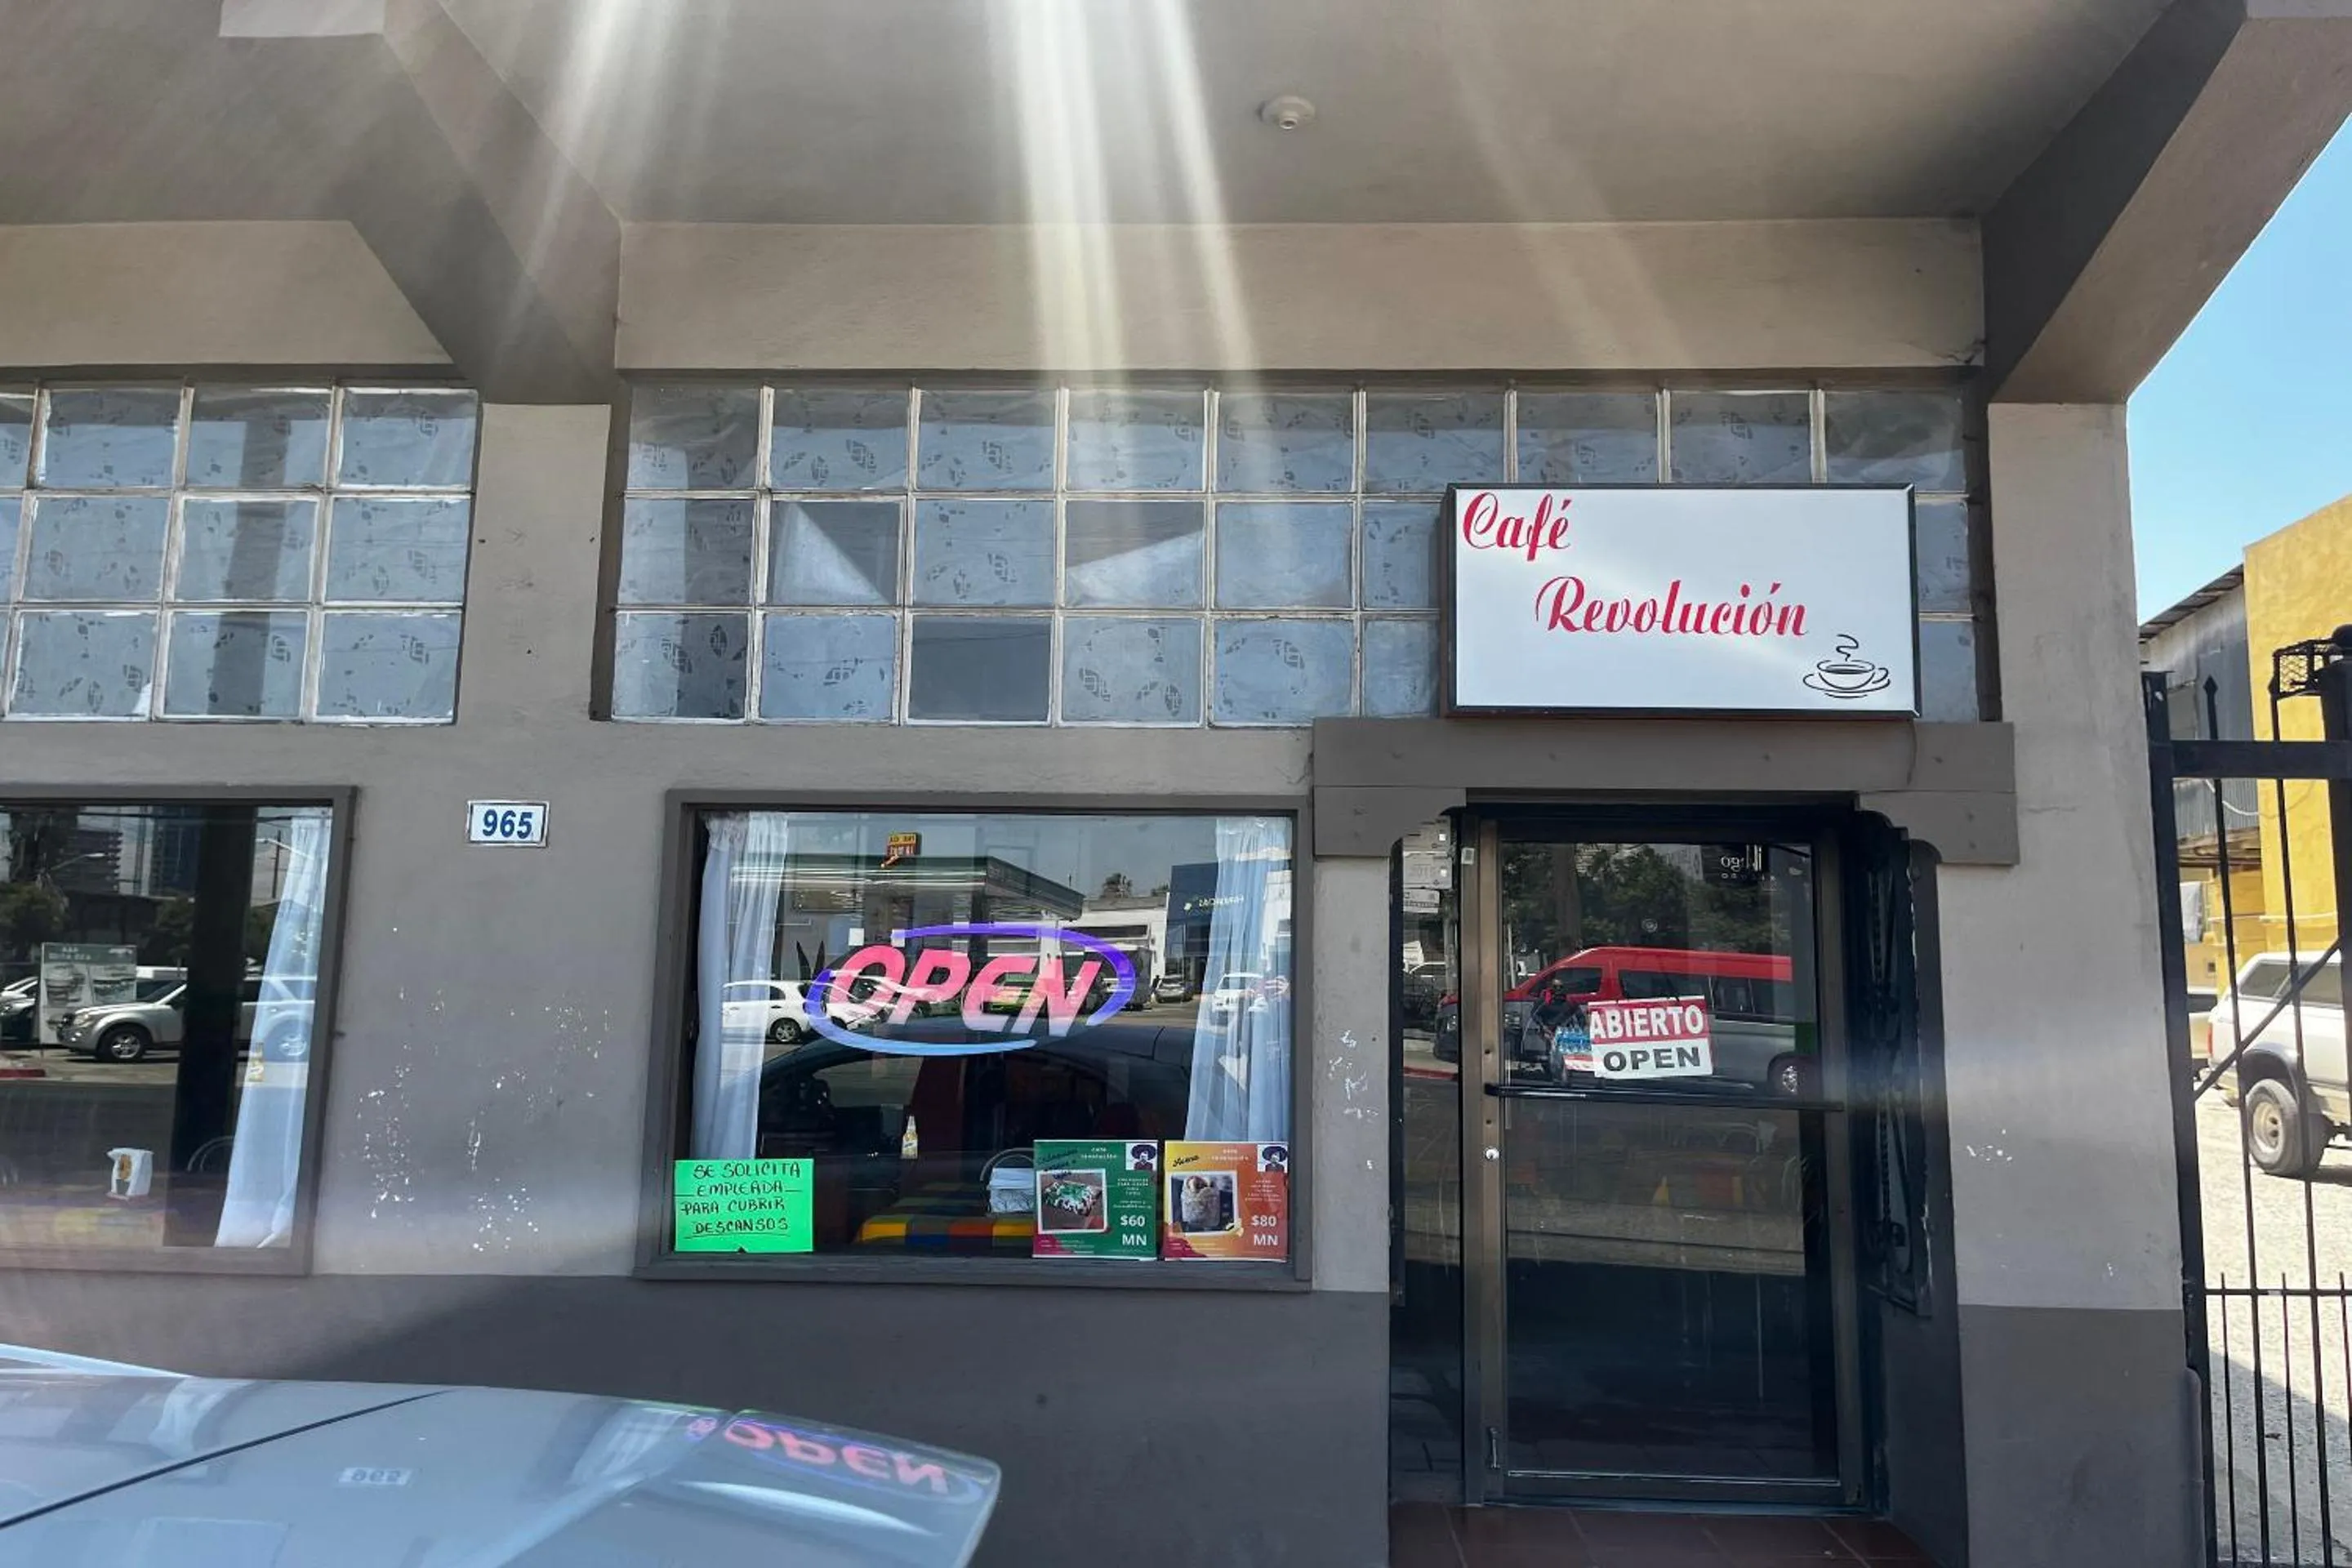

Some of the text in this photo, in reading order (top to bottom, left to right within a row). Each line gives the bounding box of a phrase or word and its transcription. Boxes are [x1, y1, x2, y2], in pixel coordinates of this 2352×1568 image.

[1463, 492, 1571, 561] Café
[1535, 576, 1807, 636] Revolución
[483, 809, 533, 839] 965
[826, 944, 1102, 1036] OPEN
[1590, 1004, 1704, 1039] ABIERTO
[1603, 1047, 1700, 1071] OPEN
[693, 1162, 800, 1178] SE SOLICITA
[697, 1180, 782, 1196] EMPLEADA
[681, 1196, 785, 1215] PARA CUBRIR
[695, 1218, 788, 1234] DESCANSOS
[1120, 1214, 1146, 1227] $60
[1251, 1214, 1276, 1227] $80
[1122, 1233, 1147, 1246] MN
[1254, 1234, 1278, 1246] MN
